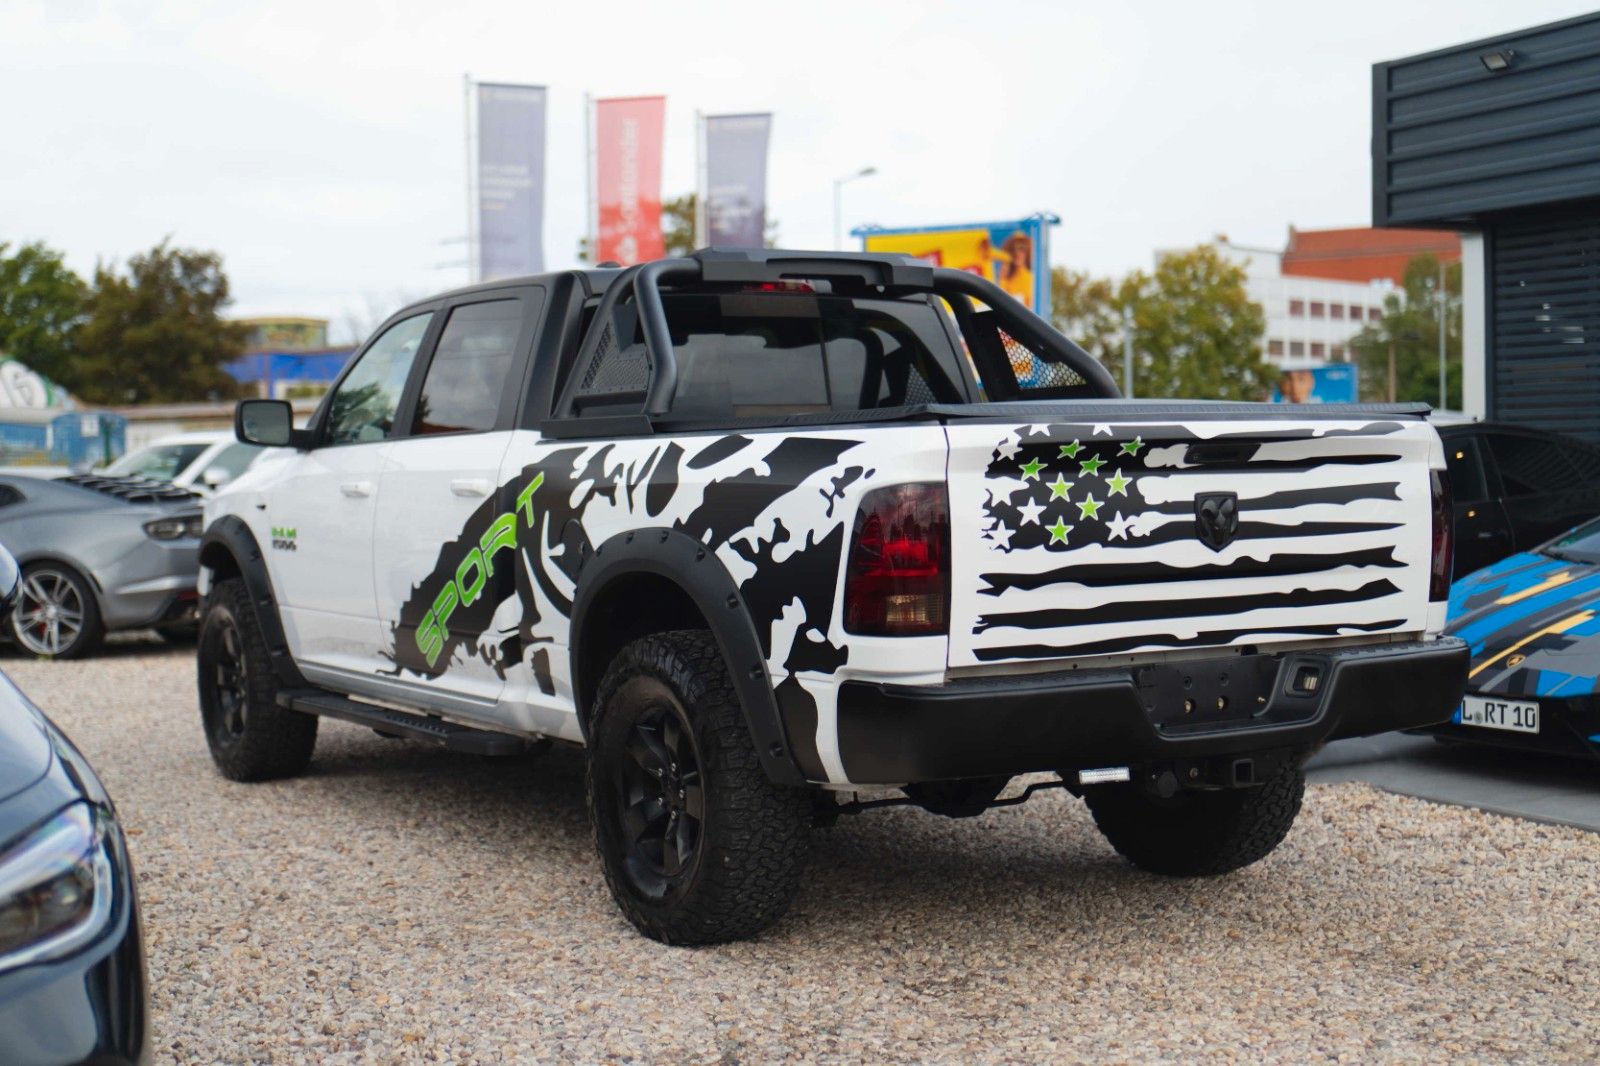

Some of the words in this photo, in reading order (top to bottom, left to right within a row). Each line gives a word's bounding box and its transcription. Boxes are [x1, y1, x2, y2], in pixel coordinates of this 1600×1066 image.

[416, 471, 545, 668] SPORT
[1484, 702, 1508, 725] RT
[1513, 705, 1536, 728] 10
